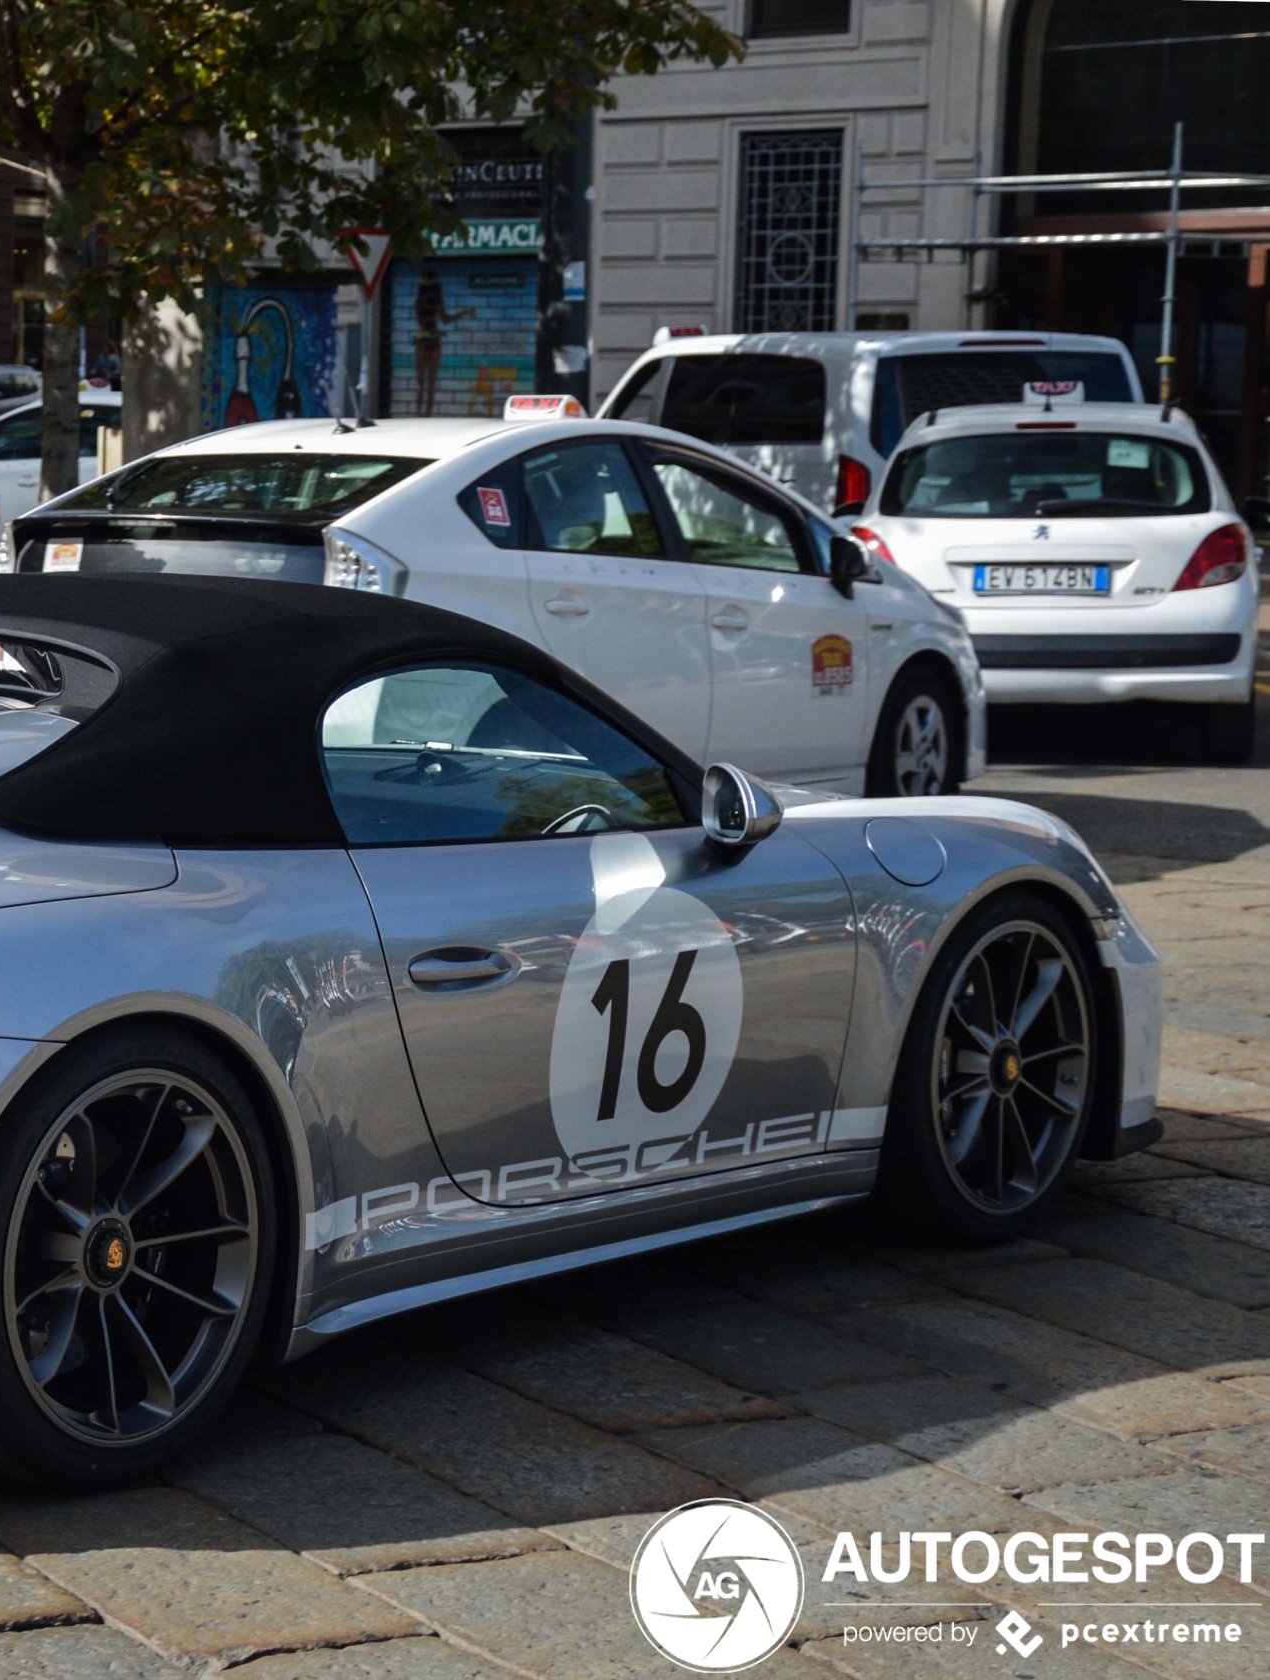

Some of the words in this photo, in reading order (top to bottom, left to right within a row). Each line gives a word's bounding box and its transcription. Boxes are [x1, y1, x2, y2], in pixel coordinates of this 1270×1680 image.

[1032, 381, 1075, 393] TAXI
[512, 397, 560, 410] TAXI
[990, 567, 1014, 588] EV
[591, 950, 706, 1121] 16
[360, 1111, 817, 1230] PORSCHE
